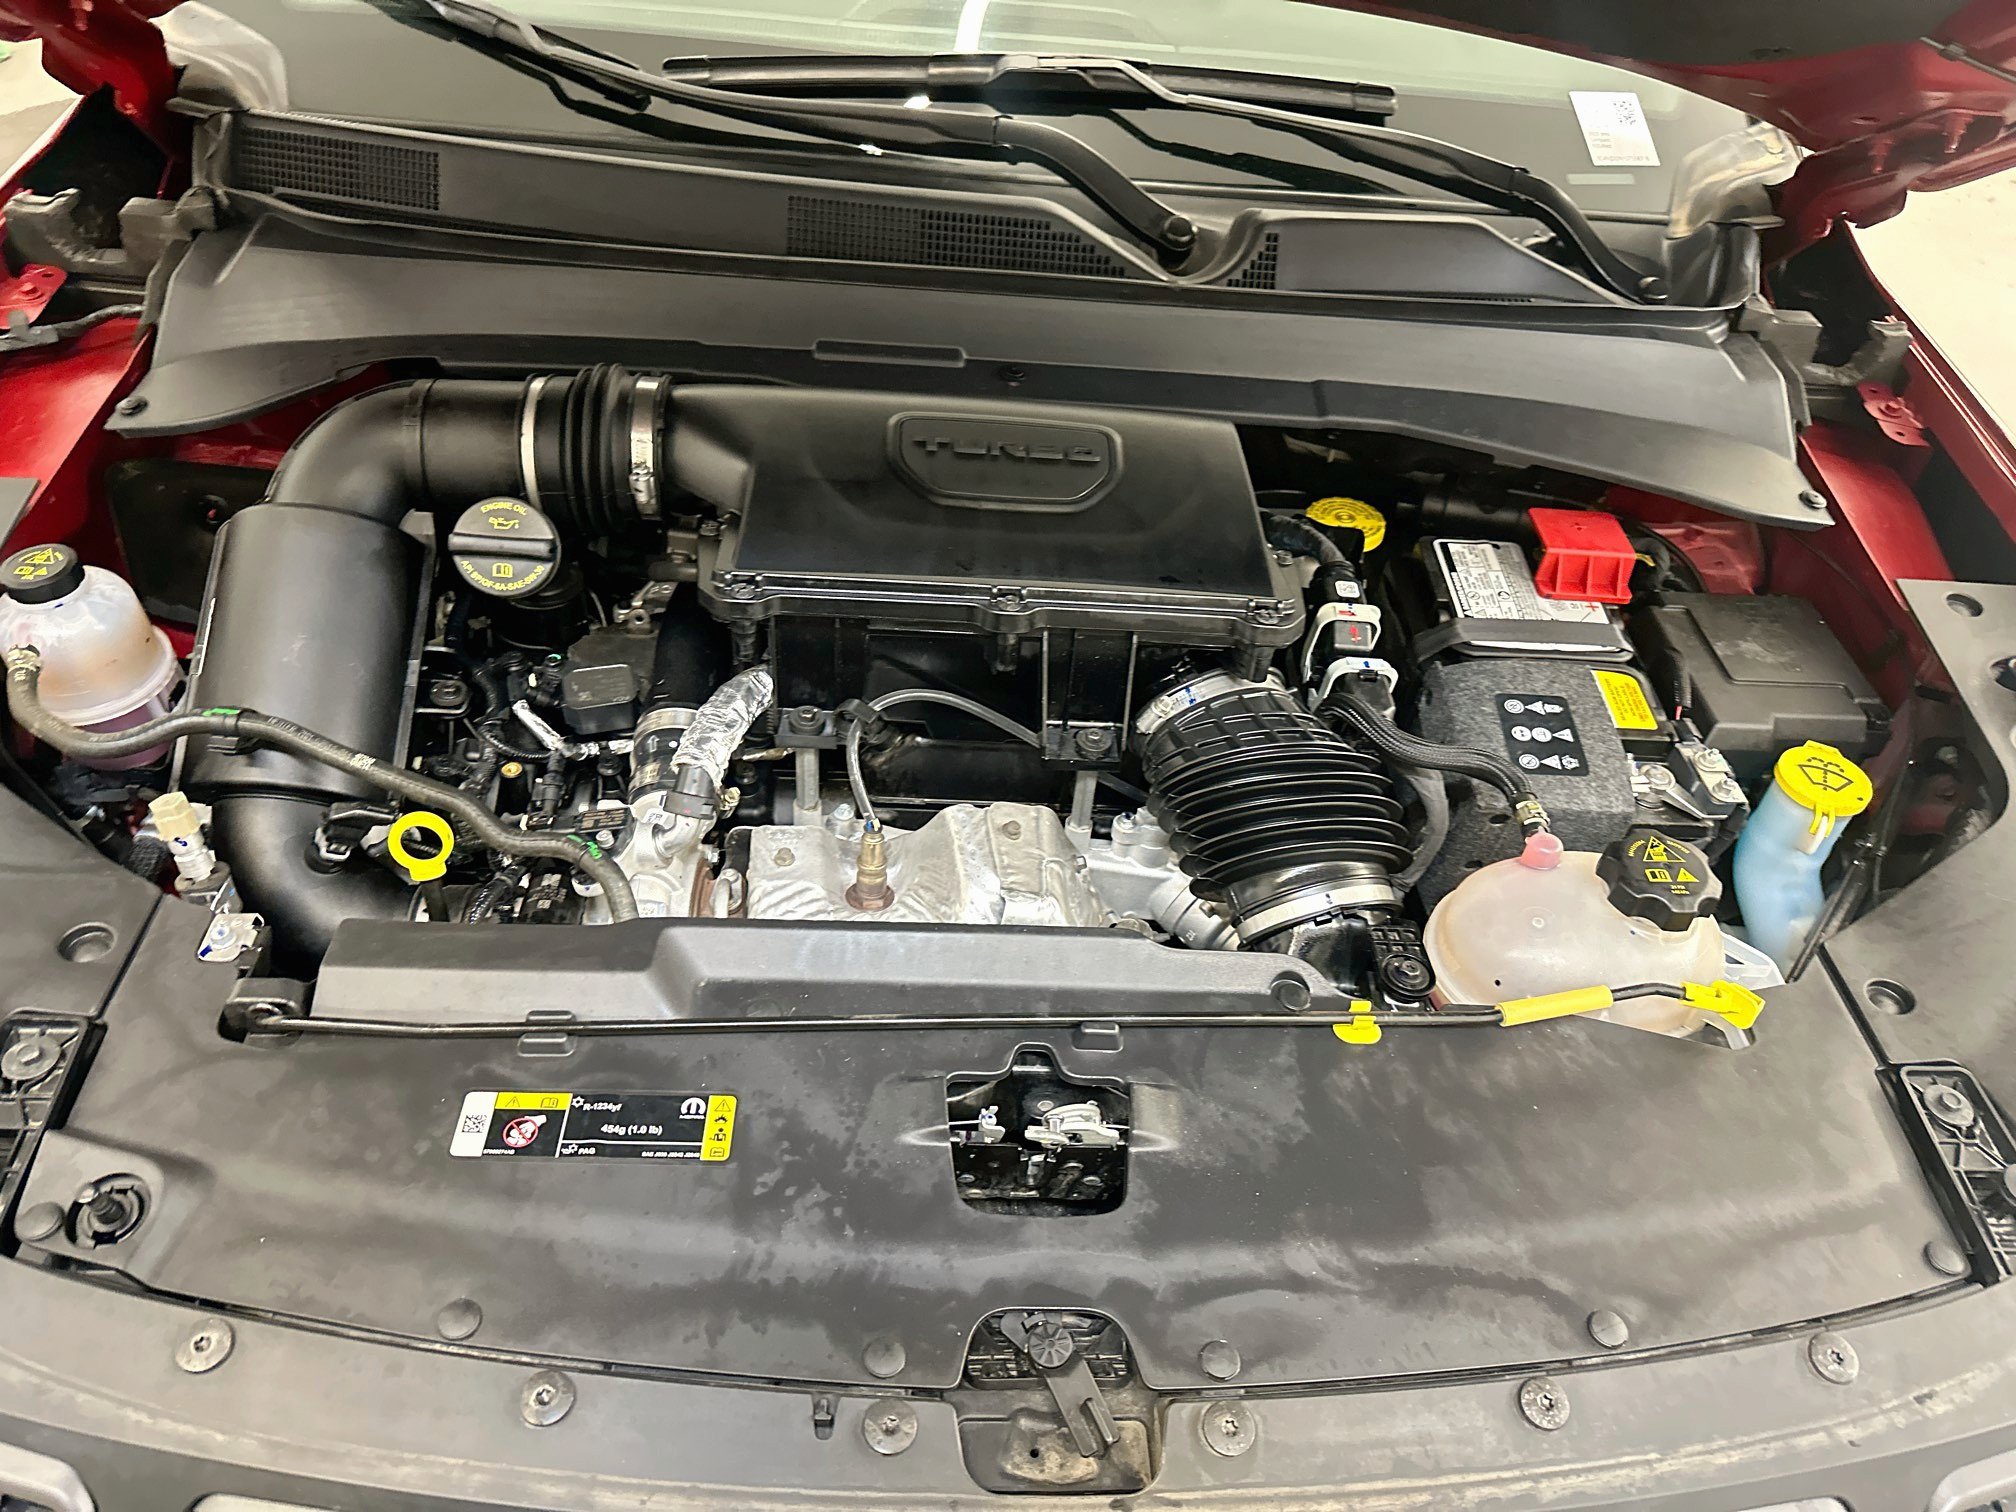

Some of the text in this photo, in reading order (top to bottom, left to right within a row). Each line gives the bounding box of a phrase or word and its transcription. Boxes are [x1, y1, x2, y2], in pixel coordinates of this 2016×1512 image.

[911, 437, 1101, 464] TURBO
[480, 502, 528, 516] ENGINE OIL
[461, 561, 472, 574] API
[582, 1102, 622, 1112] R-1234yf
[600, 1124, 663, 1136] 454g (1.0 lb)
[578, 1147, 596, 1155] PAG
